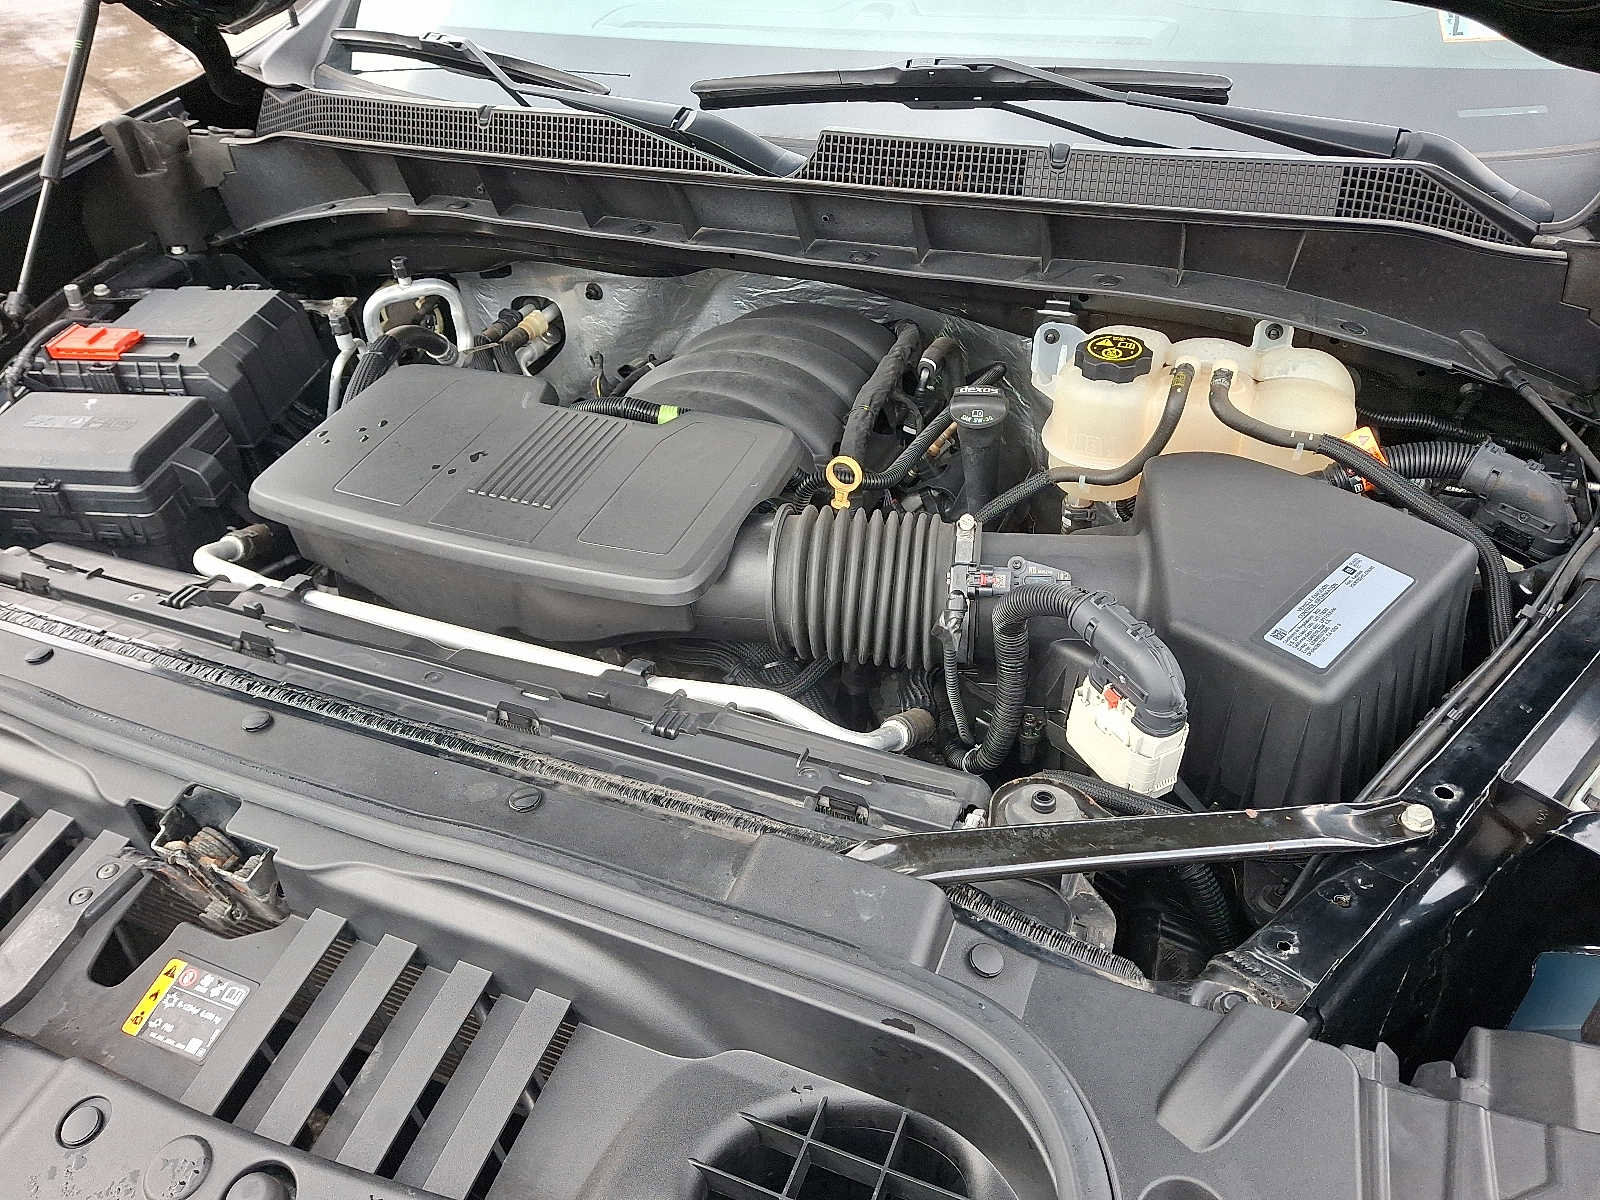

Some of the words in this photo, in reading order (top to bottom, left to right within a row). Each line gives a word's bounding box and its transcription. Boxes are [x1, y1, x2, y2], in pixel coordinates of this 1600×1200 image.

[960, 386, 999, 394] dexos
[1296, 598, 1313, 612] VEHICLE
[1297, 602, 1316, 619] CONTROL
